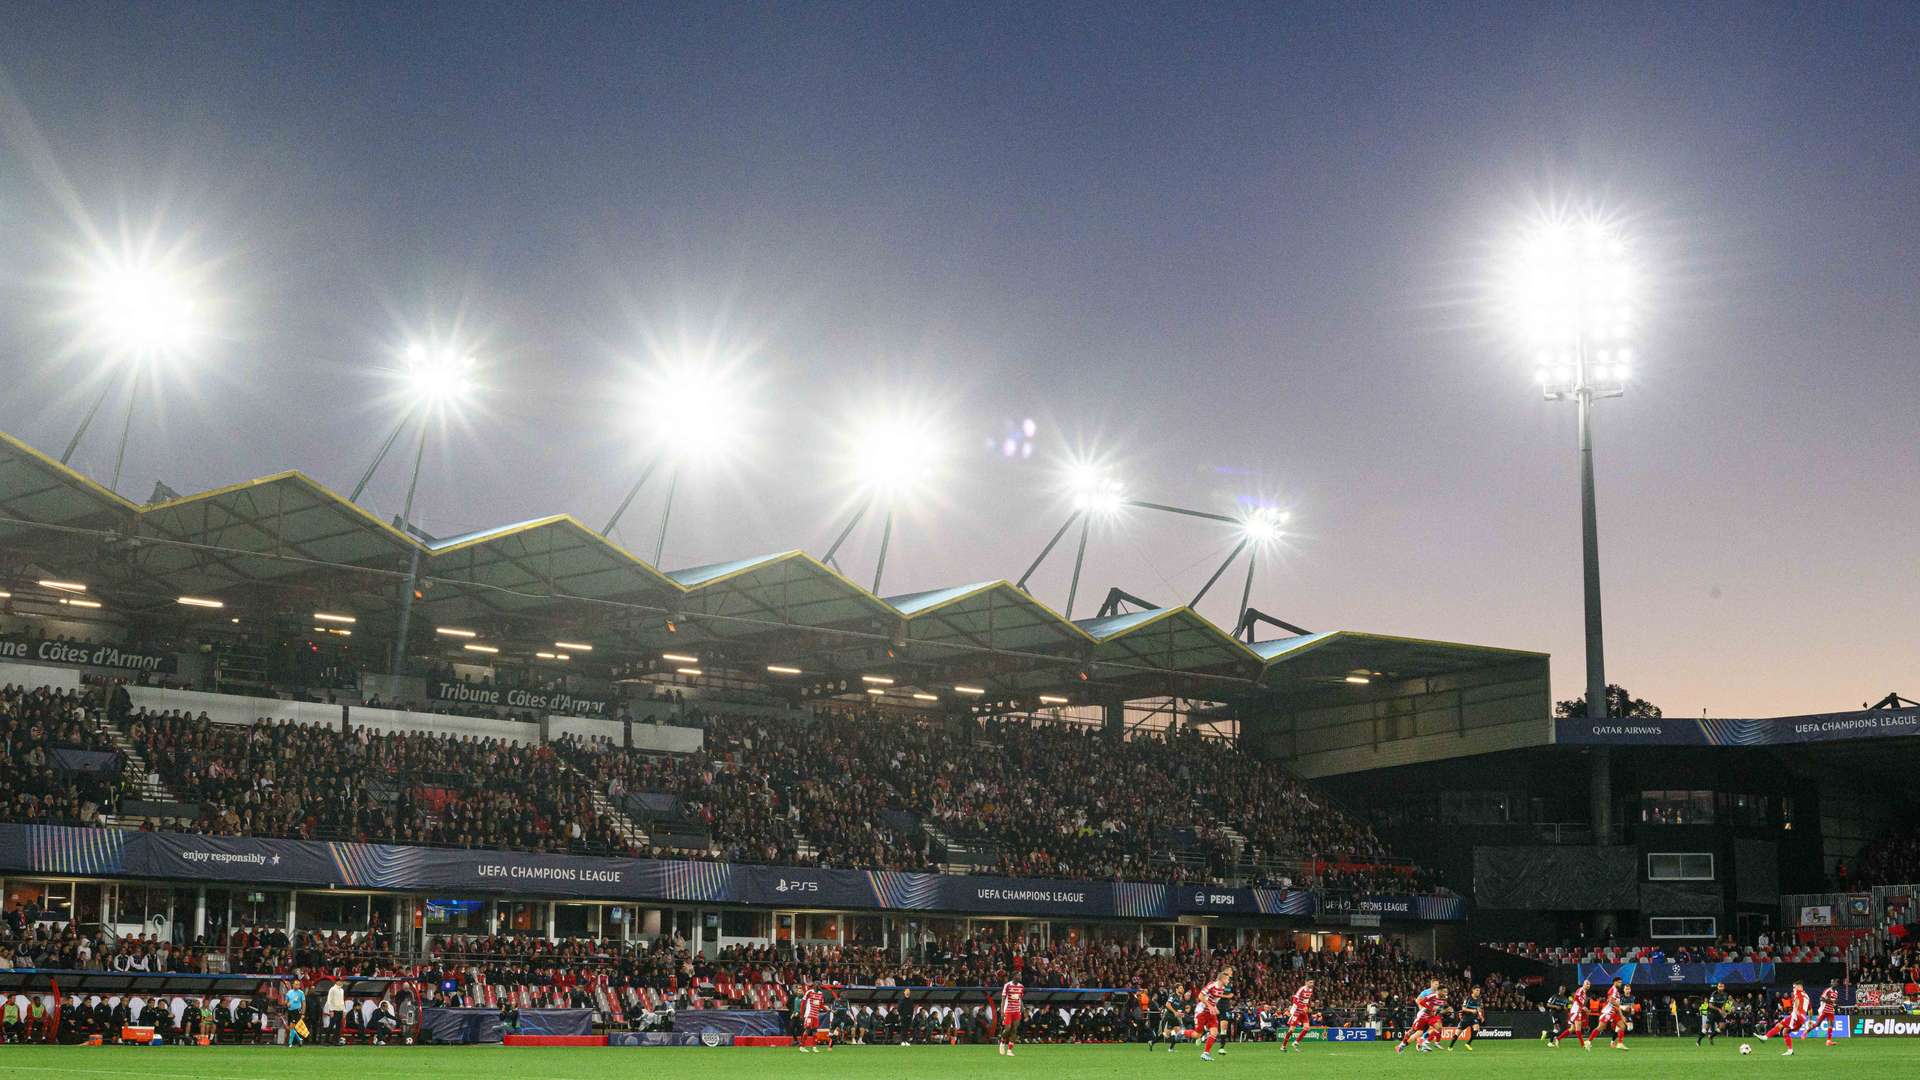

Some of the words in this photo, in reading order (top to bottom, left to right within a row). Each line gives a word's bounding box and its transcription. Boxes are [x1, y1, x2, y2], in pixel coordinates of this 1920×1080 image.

[38, 641, 88, 663] Côtes
[92, 646, 162, 670] d'Armor
[440, 683, 499, 703] Tribune
[507, 689, 547, 708] Côtes
[1592, 726, 1622, 735] QATAR
[1624, 726, 1662, 734] AIRWAYS
[1795, 723, 1820, 733] UEFA
[1822, 718, 1878, 731] CHAMPIONS
[1880, 715, 1917, 727] LEAGUE
[182, 850, 209, 862] enjoy
[211, 853, 267, 865] responsibly
[478, 865, 507, 877] UEFA
[510, 866, 576, 880] CHAMPIONS
[579, 870, 621, 882] LEAGUE
[790, 881, 818, 891] PS5
[977, 889, 1000, 899] UEFA
[1002, 889, 1051, 901] CHAMPIONS
[1053, 892, 1084, 902] LEAGUE
[1210, 894, 1235, 905] PEPSI
[1383, 902, 1409, 911] LEAGUE
[1346, 1030, 1368, 1040] PS5
